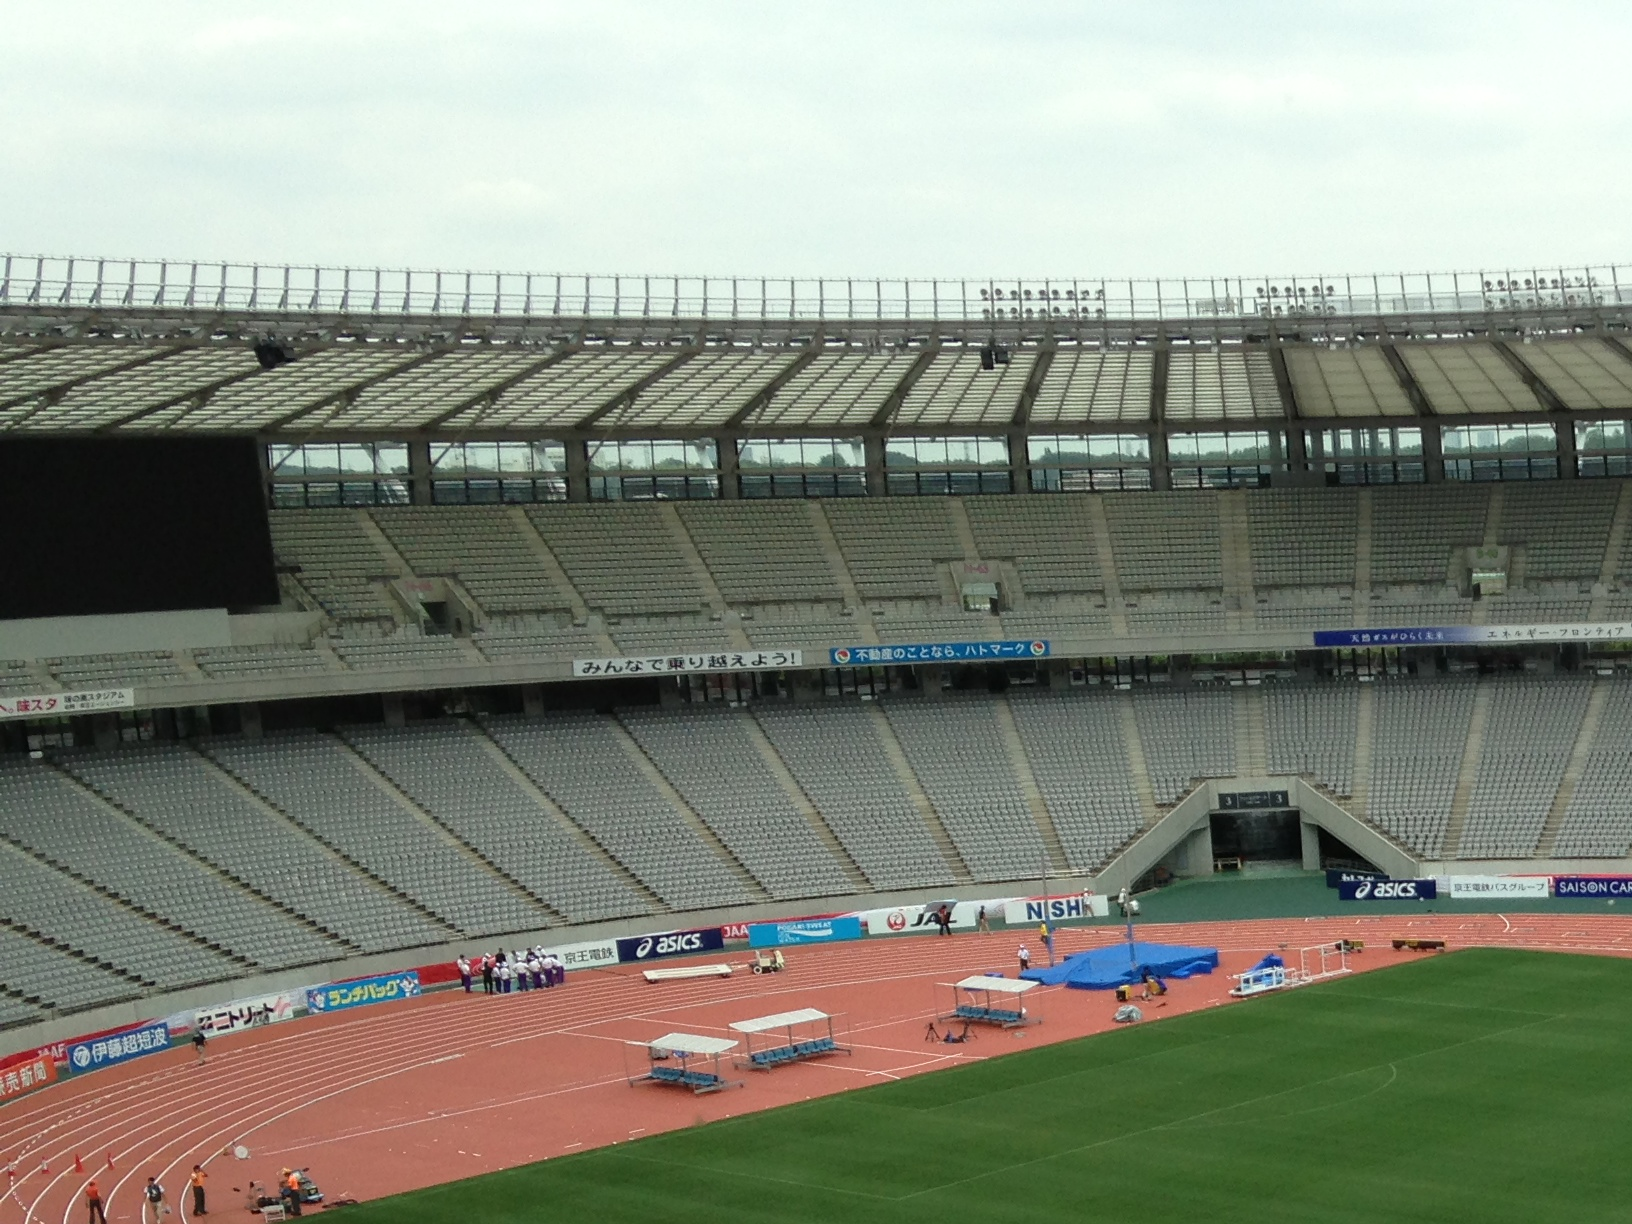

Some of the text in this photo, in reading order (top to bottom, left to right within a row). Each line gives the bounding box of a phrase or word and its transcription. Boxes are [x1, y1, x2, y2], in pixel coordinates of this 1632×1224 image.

[855, 643, 1026, 661] 不動産のことなら、ハトマーク
[1374, 882, 1416, 897] asics
[1560, 881, 1608, 893] SAISON
[656, 933, 701, 954] asics
[564, 947, 614, 964] 京王電鉄
[92, 1027, 168, 1063] 伊藤超短波
[0, 1061, 47, 1096] 売新聞
